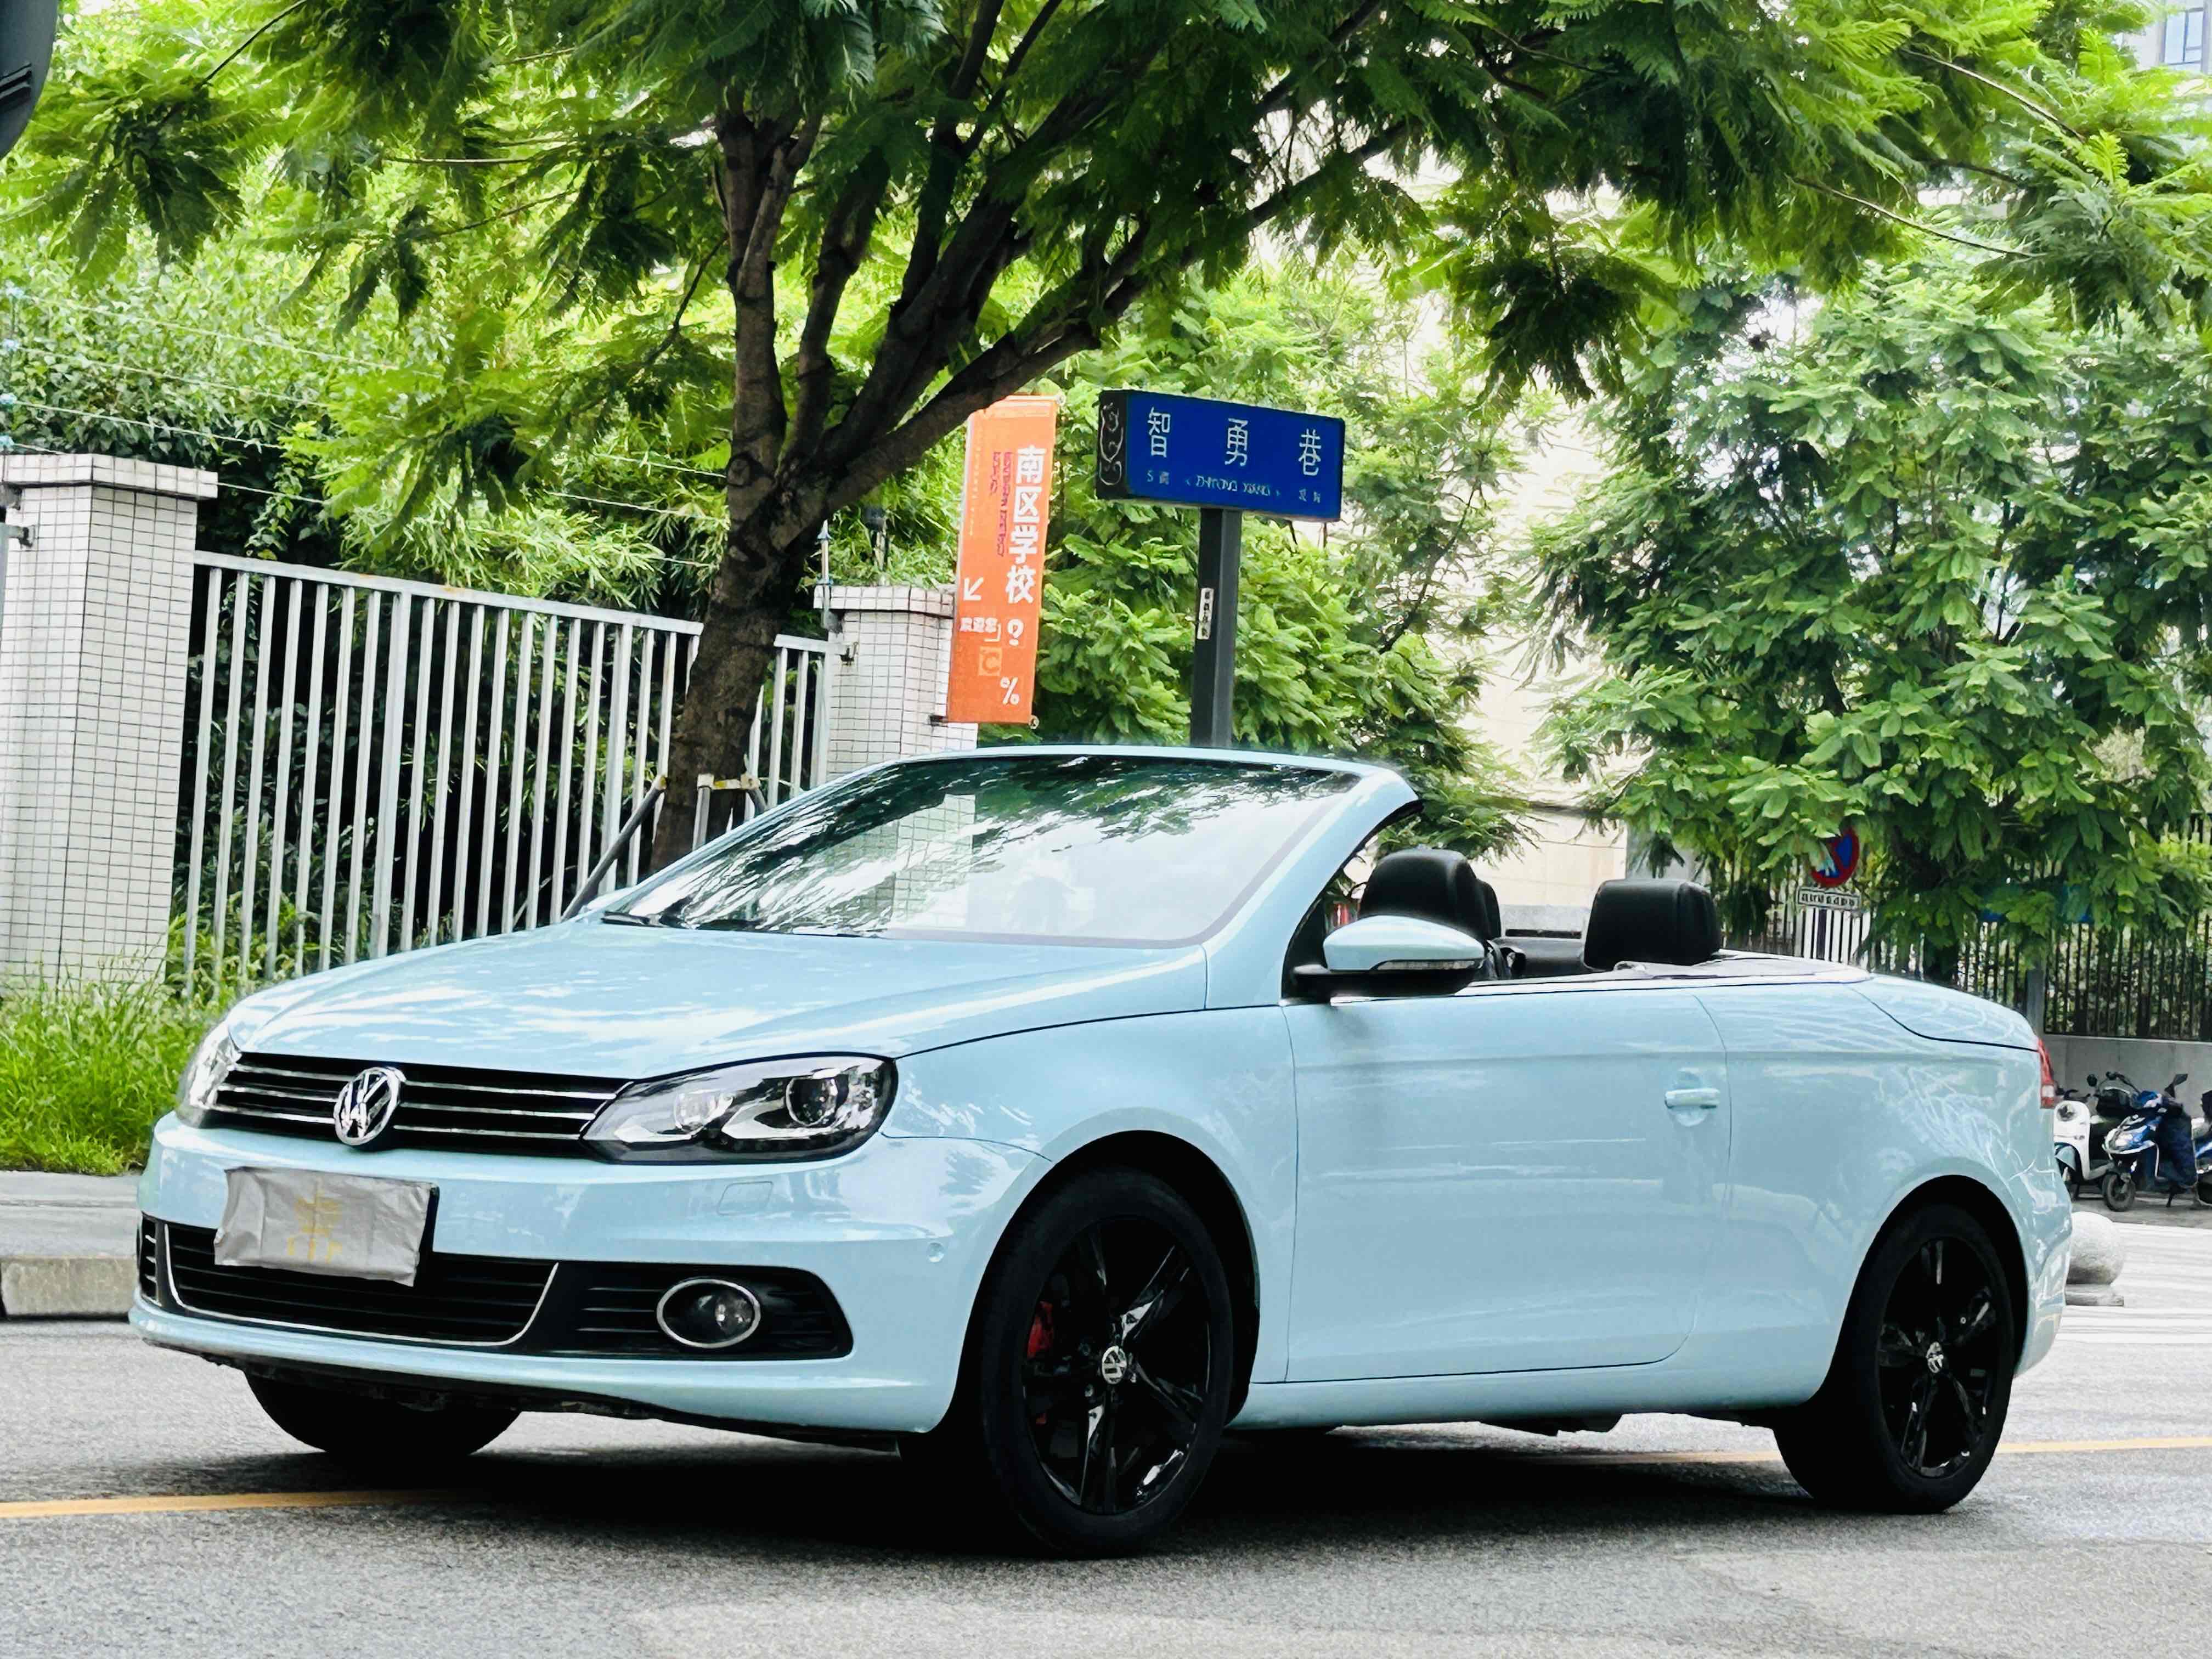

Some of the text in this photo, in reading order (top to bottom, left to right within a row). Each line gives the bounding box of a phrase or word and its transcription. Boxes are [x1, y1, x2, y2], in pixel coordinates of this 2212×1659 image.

[1147, 407, 1322, 476] 智勇巷
[1005, 444, 1047, 603] 南区学校
